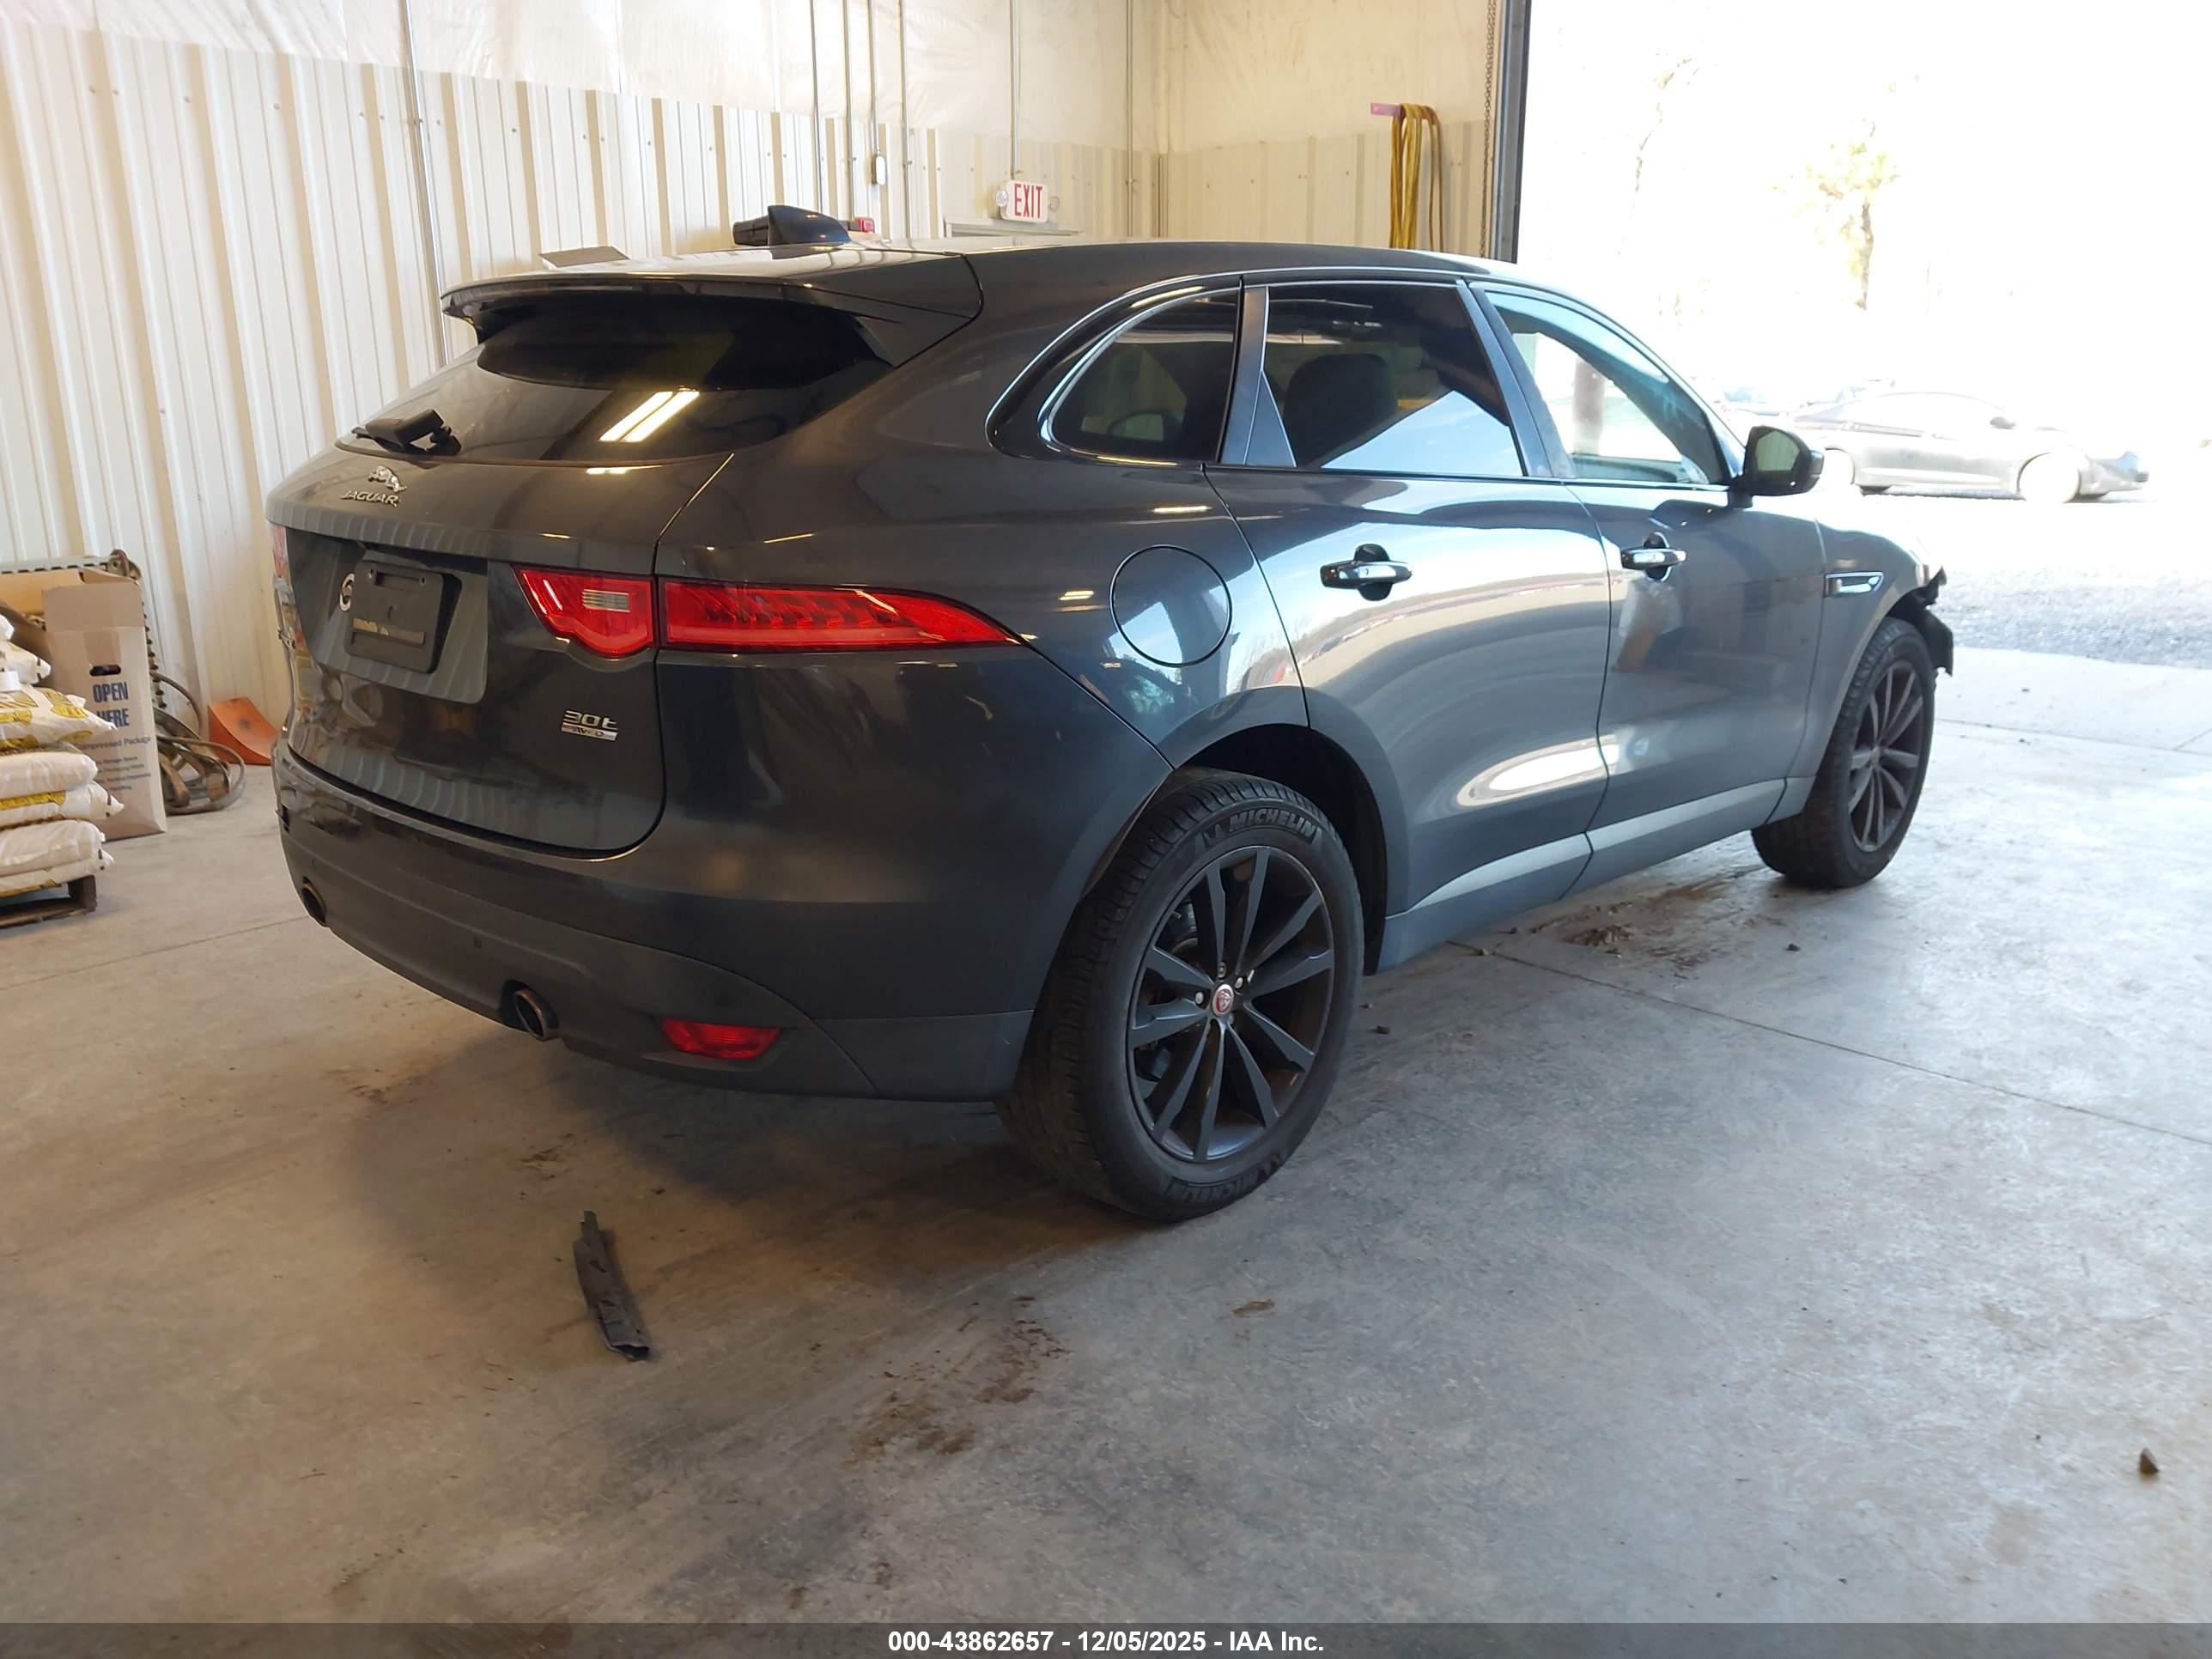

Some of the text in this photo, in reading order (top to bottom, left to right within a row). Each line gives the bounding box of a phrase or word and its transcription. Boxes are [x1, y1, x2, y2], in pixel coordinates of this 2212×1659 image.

[1014, 183, 1042, 219] EXIT
[340, 490, 399, 507] JAGUAR
[93, 682, 129, 702] OPEN
[562, 710, 618, 730] 30t
[1228, 808, 1316, 838] MICHELIN
